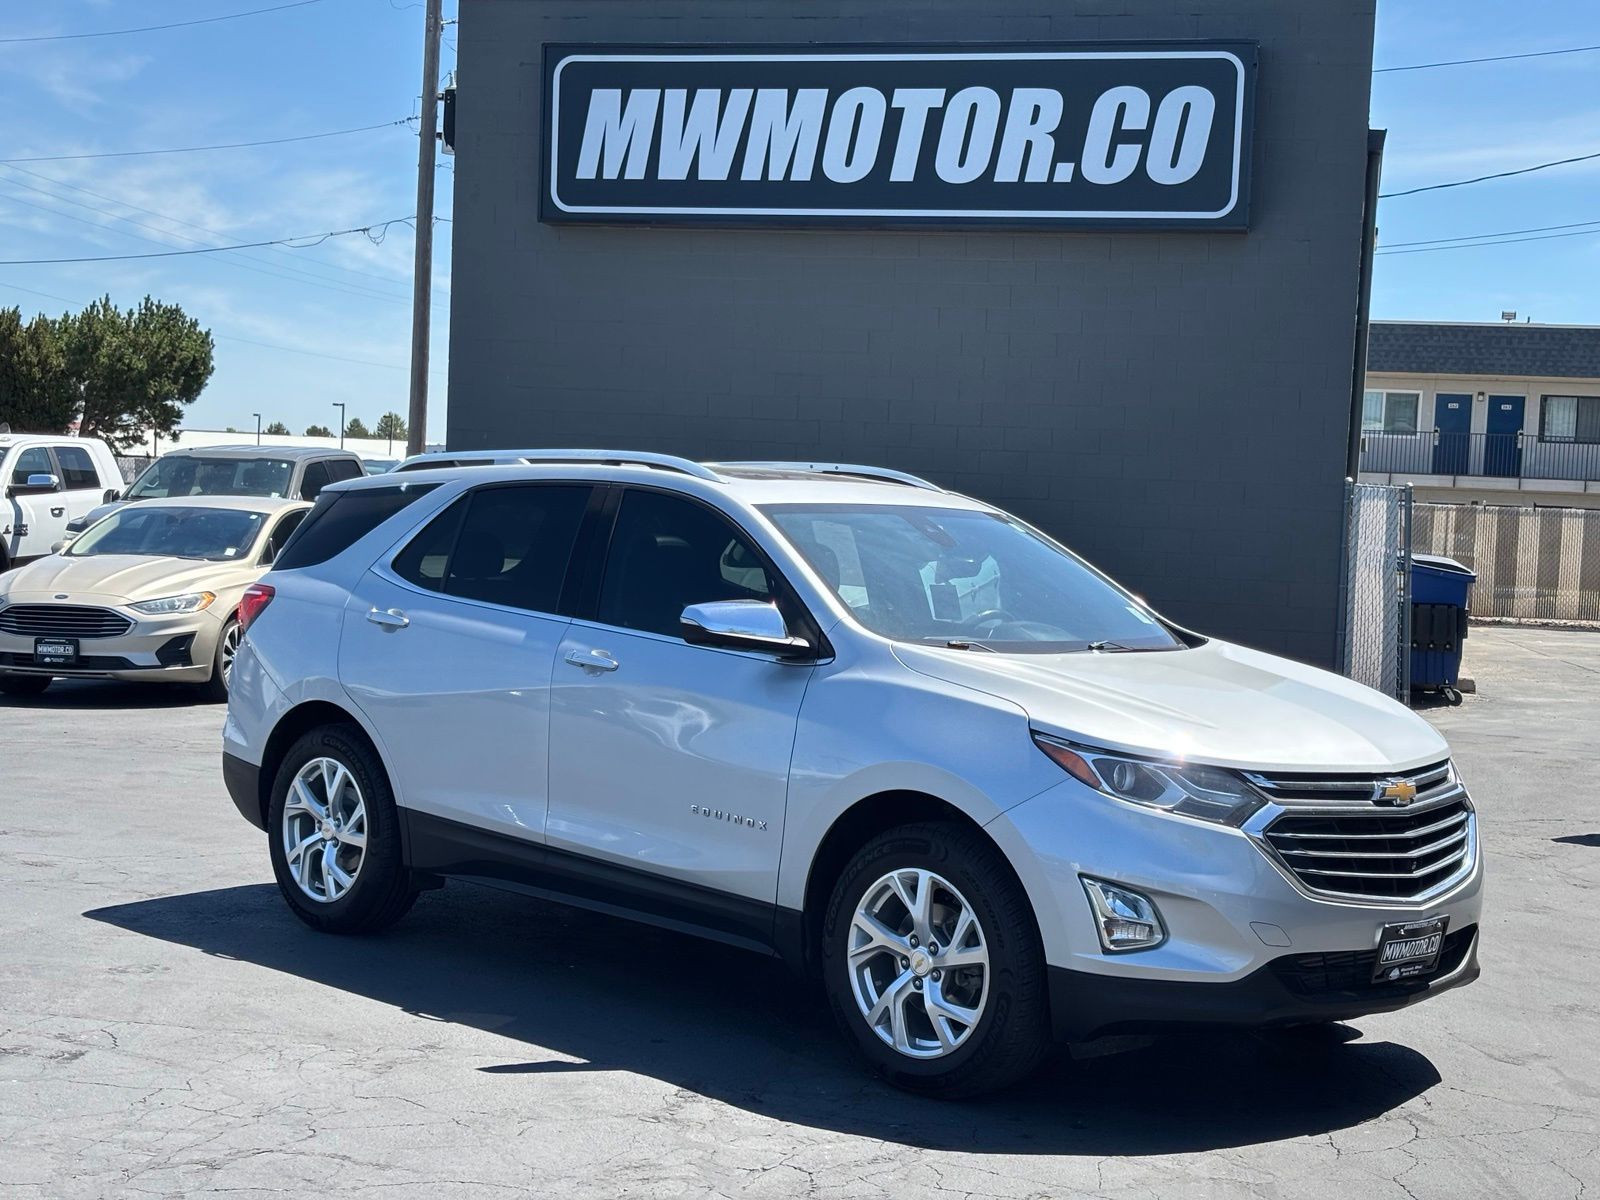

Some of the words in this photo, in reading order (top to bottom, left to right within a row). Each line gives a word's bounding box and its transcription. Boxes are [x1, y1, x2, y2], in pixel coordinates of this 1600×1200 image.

[575, 85, 1216, 185] MWMOTOR.CO
[690, 804, 768, 831] EQUINOX
[1383, 935, 1440, 961] MWMOTOR.CO
